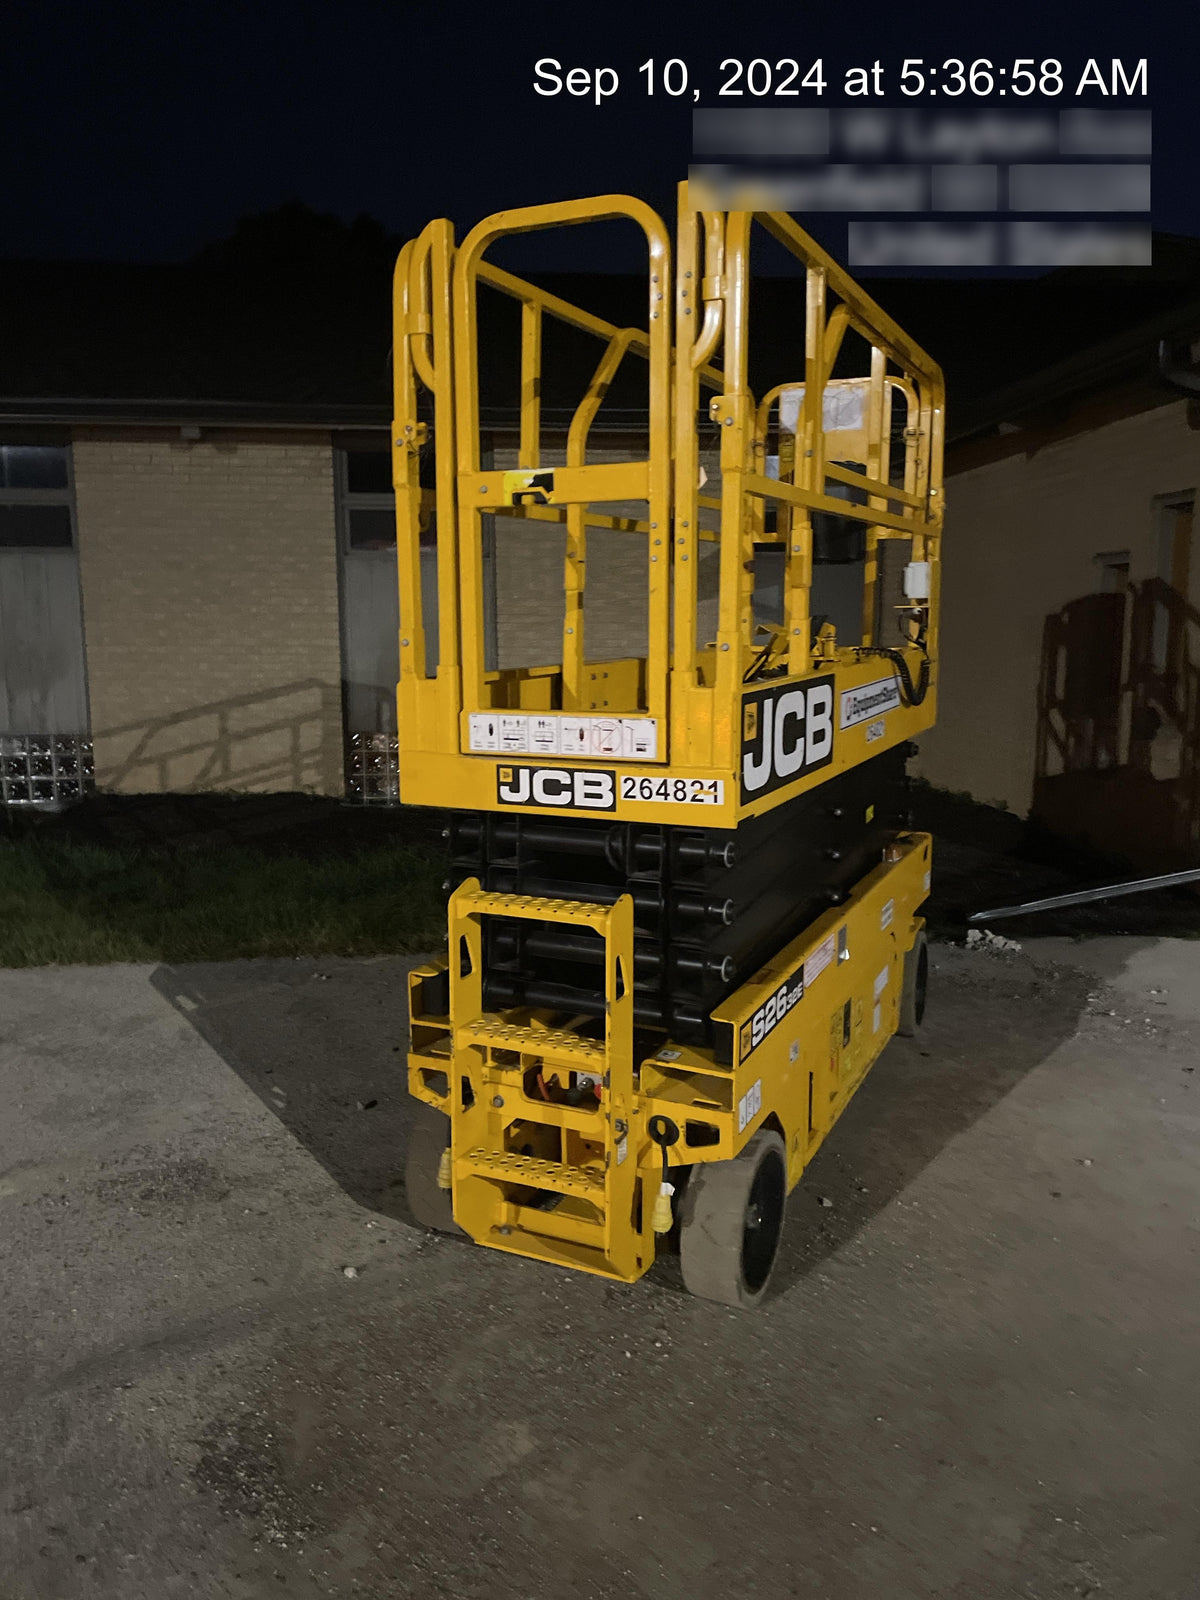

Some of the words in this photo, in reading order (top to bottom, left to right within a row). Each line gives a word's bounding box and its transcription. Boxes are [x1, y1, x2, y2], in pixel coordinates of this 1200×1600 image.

[743, 684, 832, 791] JCB
[499, 768, 614, 808] JCB
[623, 777, 719, 804] 264821
